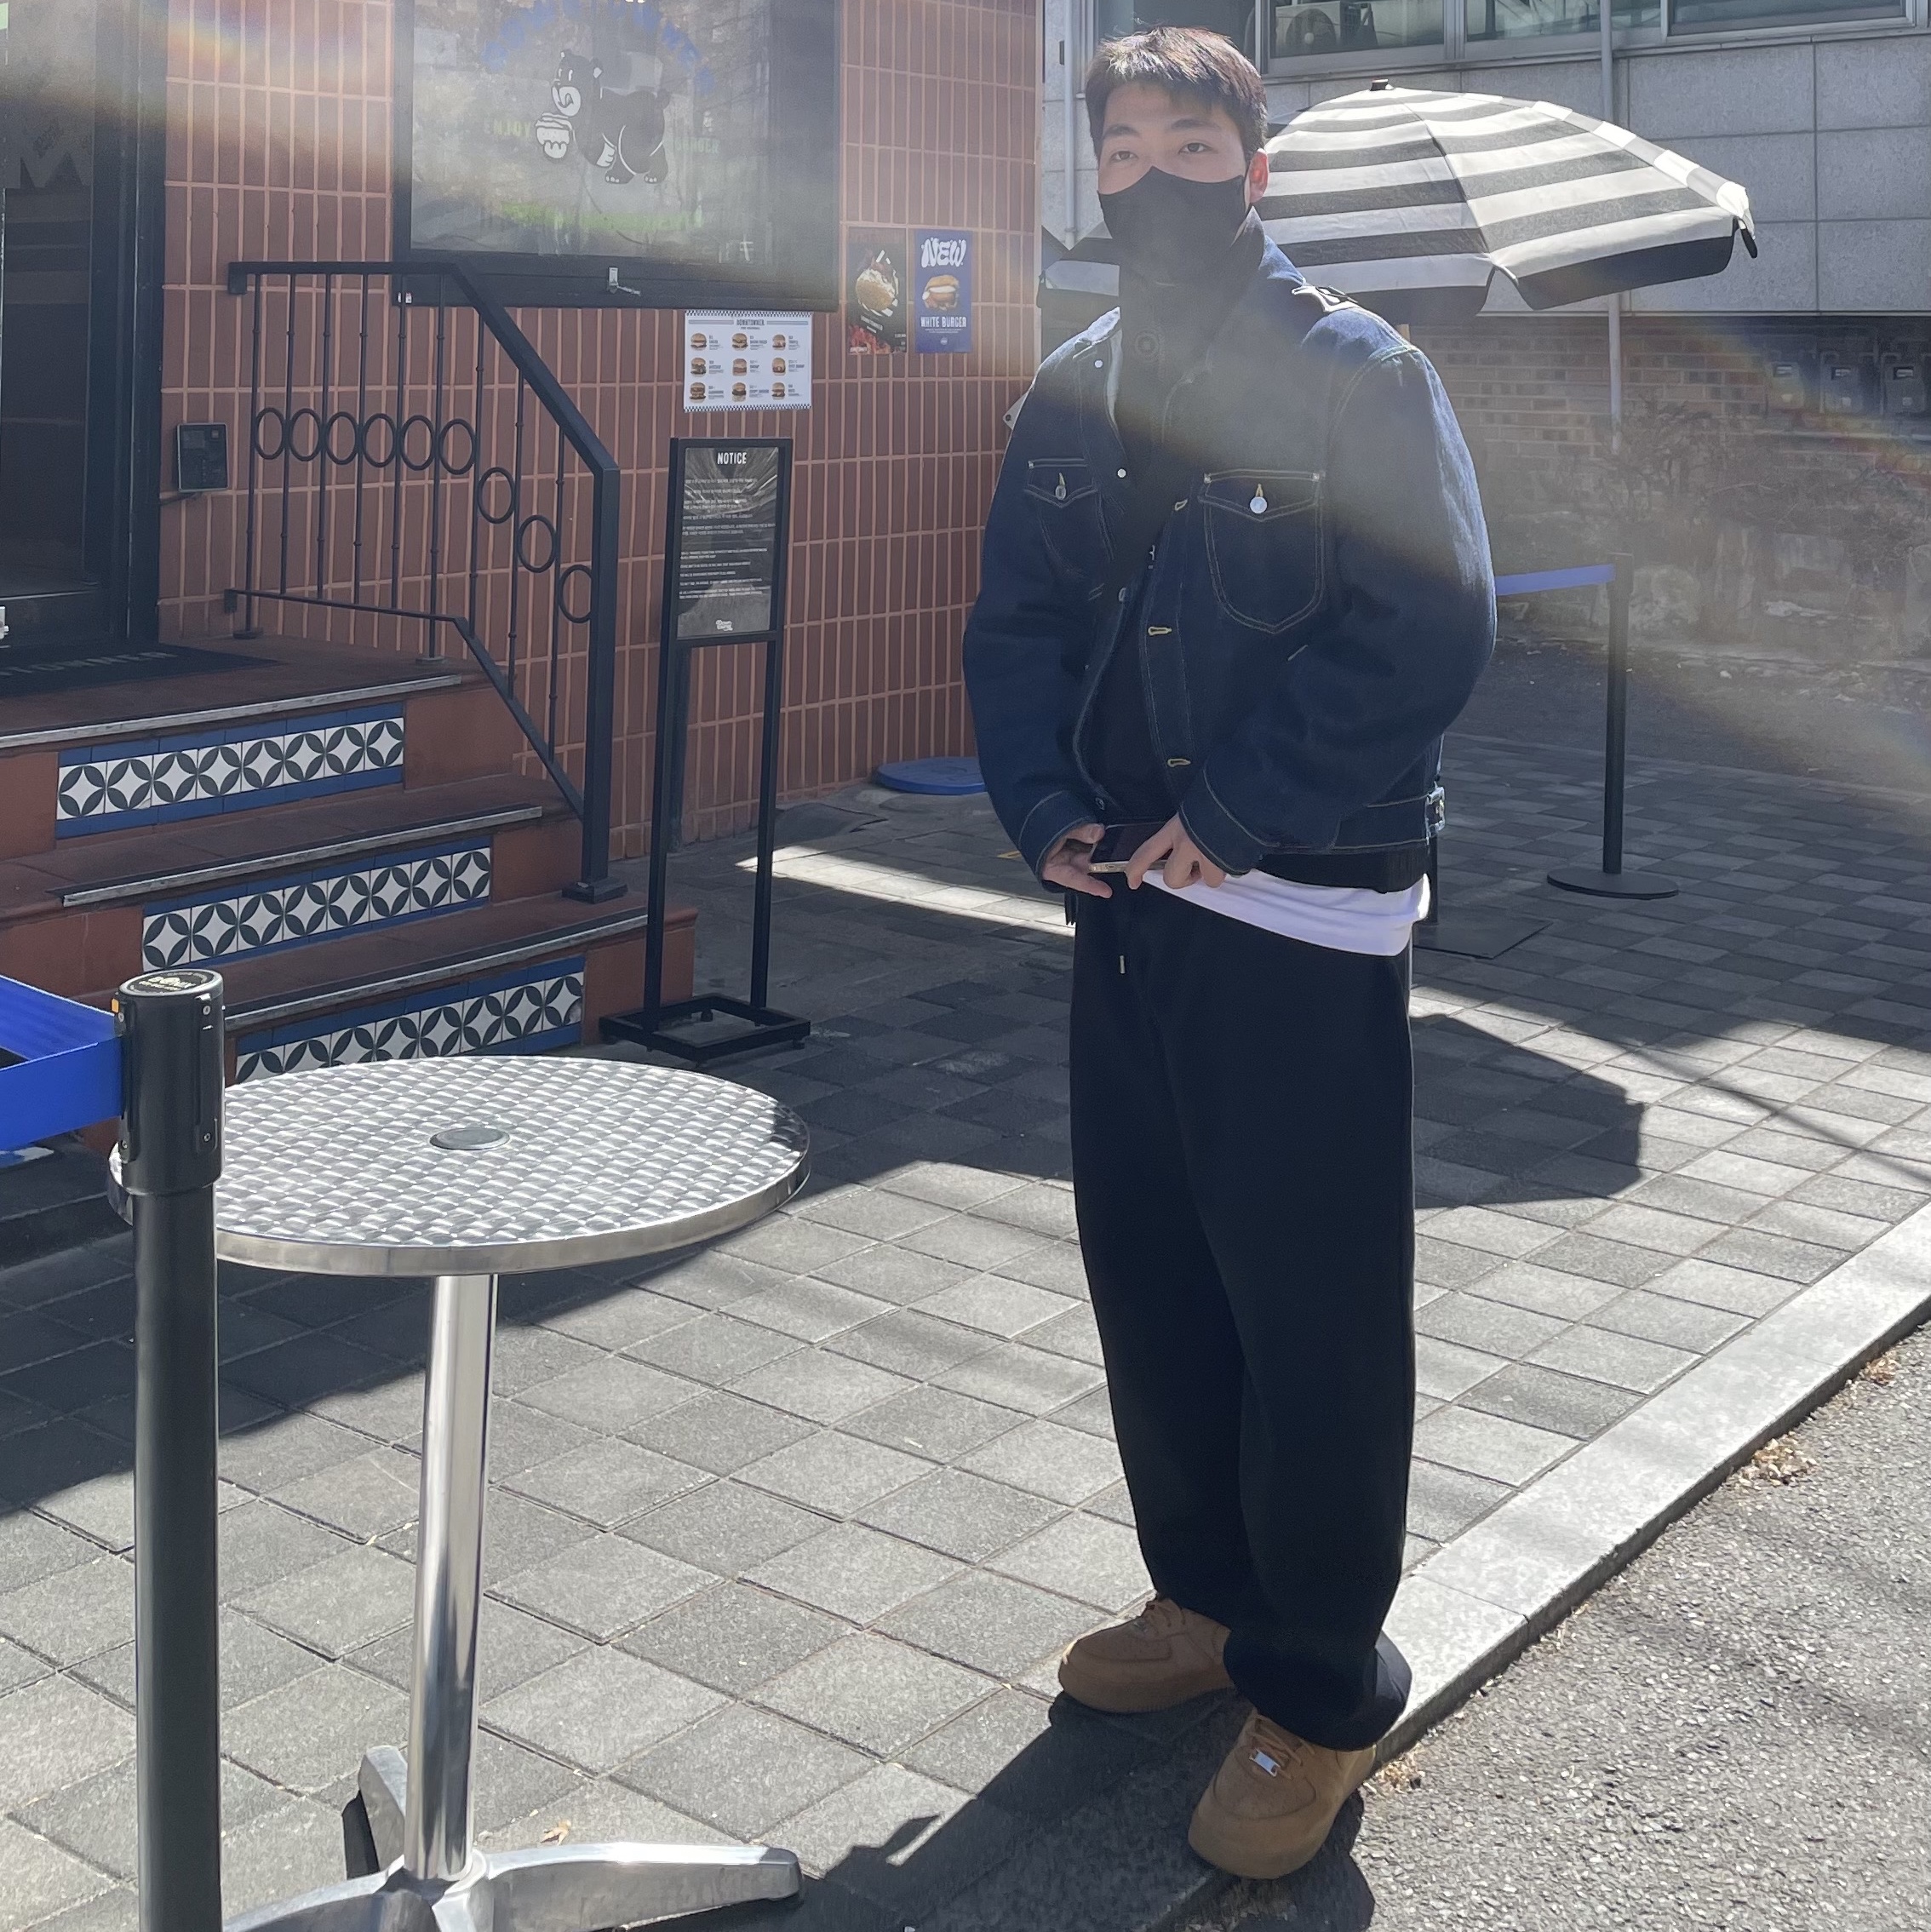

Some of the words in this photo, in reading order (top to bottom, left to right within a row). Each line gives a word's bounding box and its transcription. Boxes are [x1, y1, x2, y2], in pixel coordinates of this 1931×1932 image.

[920, 237, 967, 268] NEW
[920, 316, 940, 328] WHITE
[942, 316, 967, 328] BURGER
[717, 452, 747, 465] NOTICE
